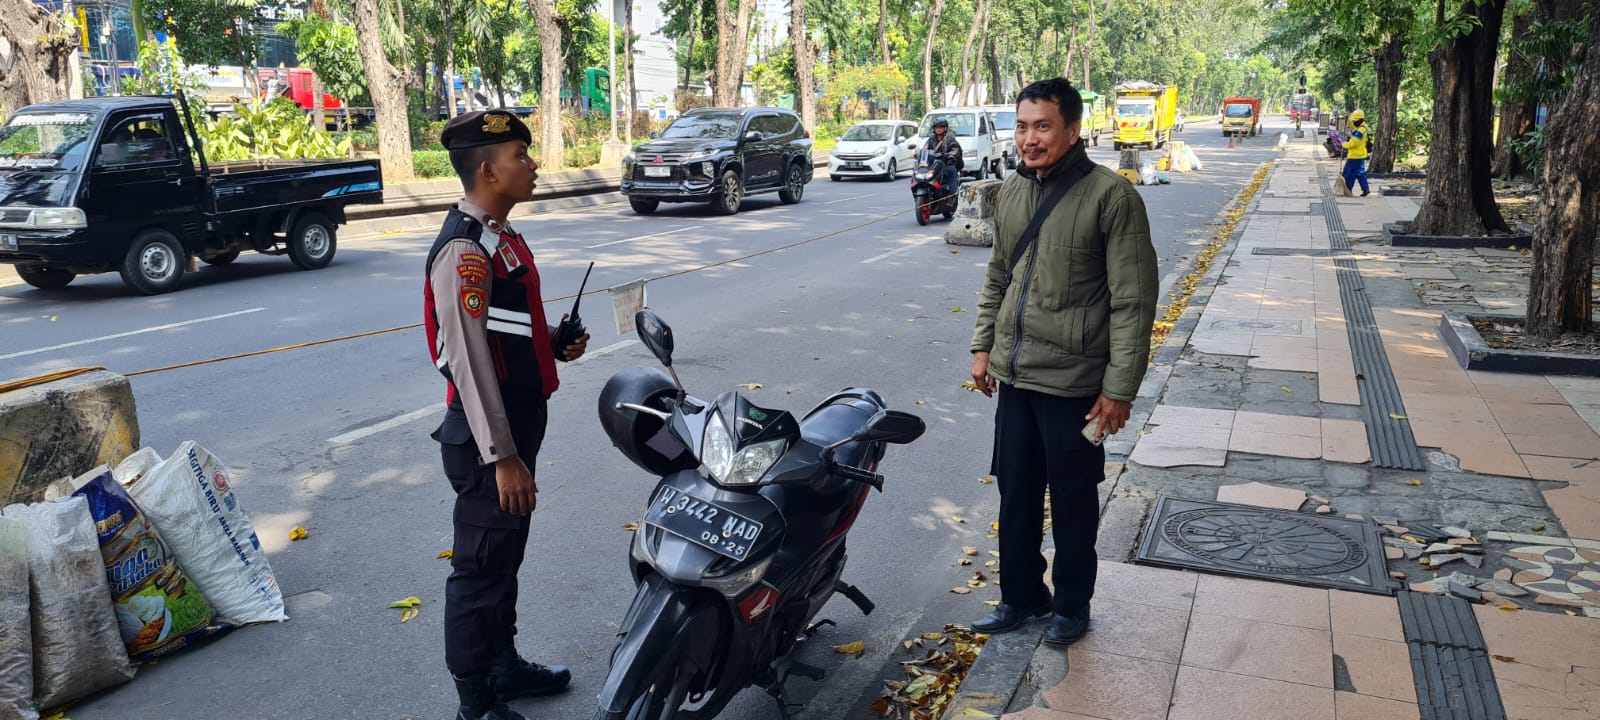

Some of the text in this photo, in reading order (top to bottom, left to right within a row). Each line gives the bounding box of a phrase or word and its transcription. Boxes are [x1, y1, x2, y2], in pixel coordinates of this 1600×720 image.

[187, 448, 208, 493] SEGITIGA
[205, 491, 221, 514] BIRU
[660, 487, 758, 540] W 3442 NAD
